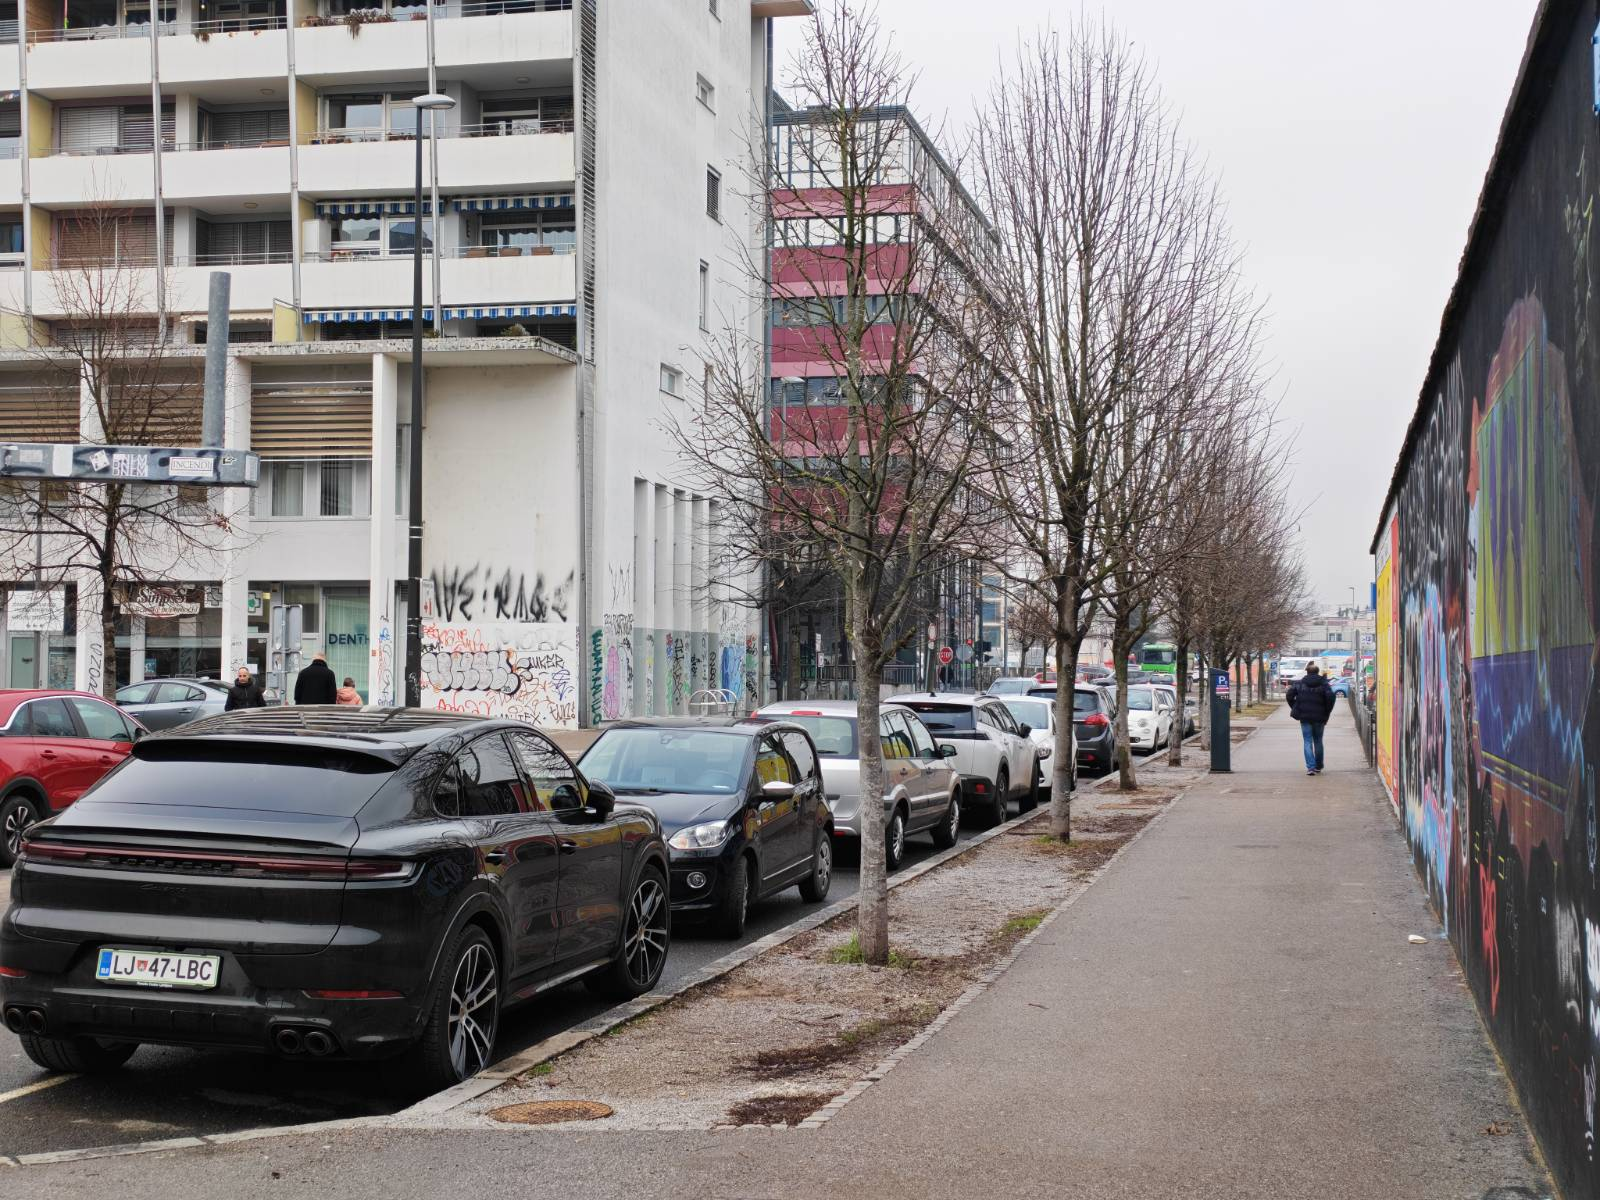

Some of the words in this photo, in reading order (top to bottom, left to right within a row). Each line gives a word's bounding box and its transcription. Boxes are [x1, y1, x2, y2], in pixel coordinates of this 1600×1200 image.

[1219, 676, 1226, 684] P
[113, 955, 135, 975] LJ
[149, 958, 212, 980] 47-LBC
